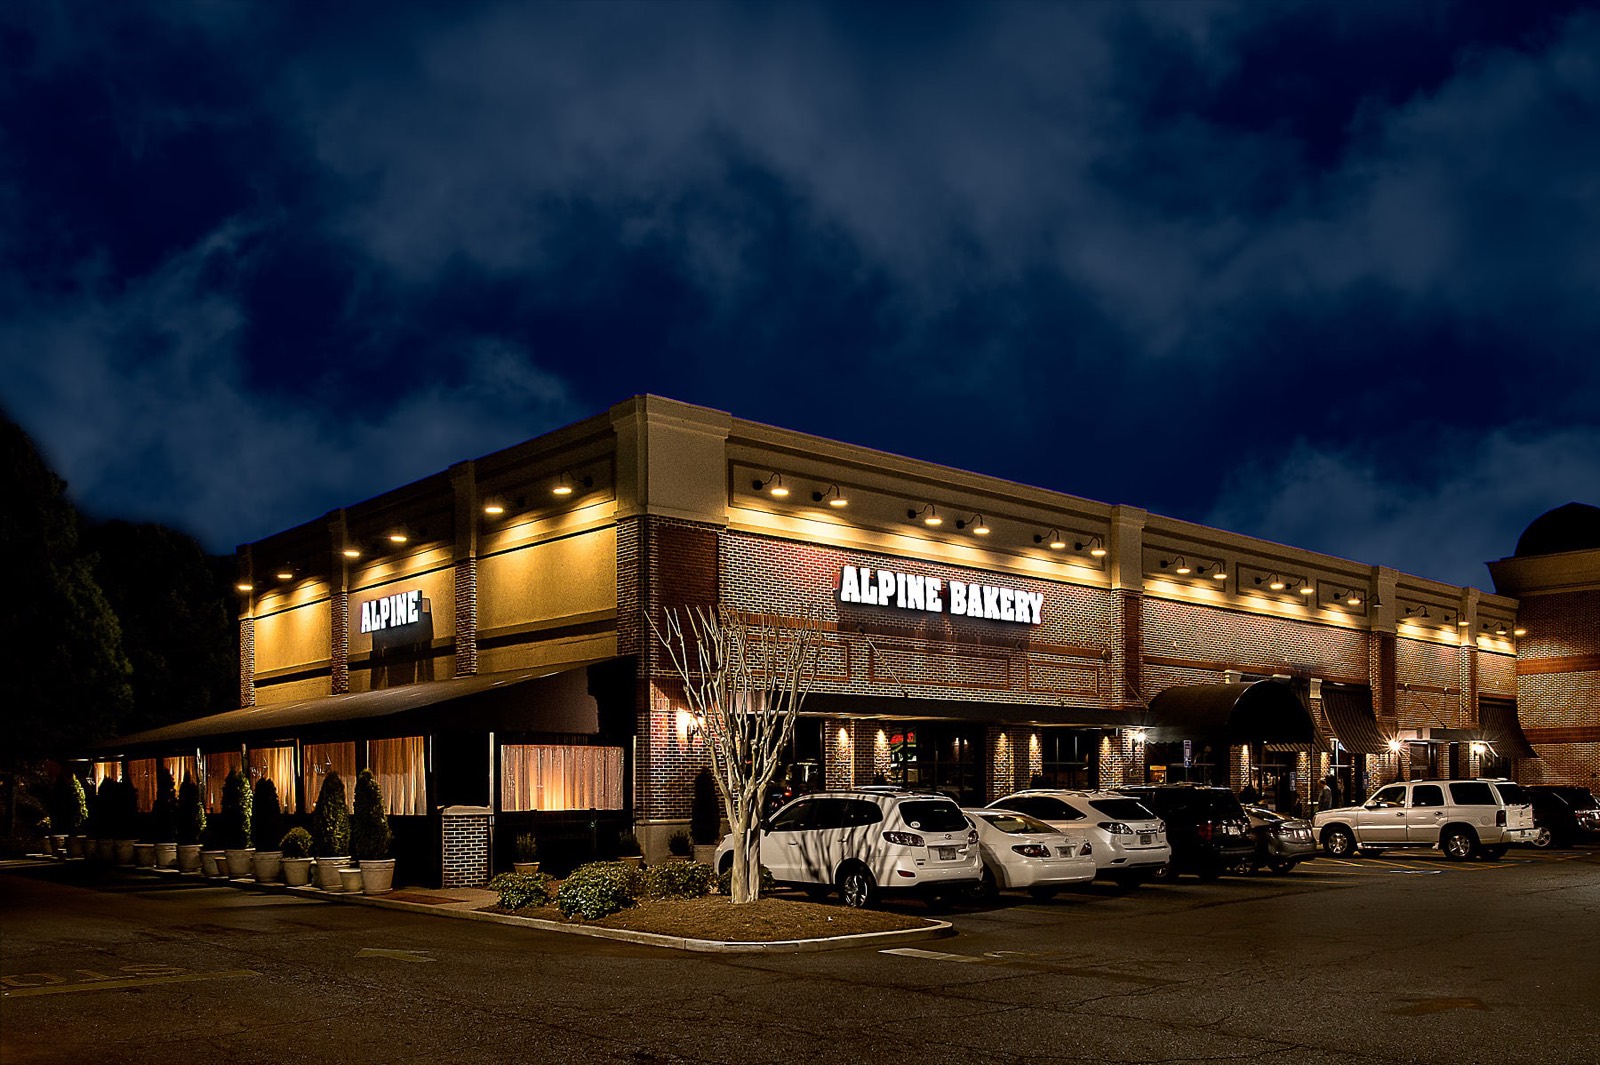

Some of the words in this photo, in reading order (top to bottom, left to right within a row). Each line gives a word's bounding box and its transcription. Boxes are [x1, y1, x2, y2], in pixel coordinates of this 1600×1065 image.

[361, 590, 419, 633] ALPINE
[840, 565, 943, 613] ALPINE
[949, 580, 1044, 625] BAKERY
